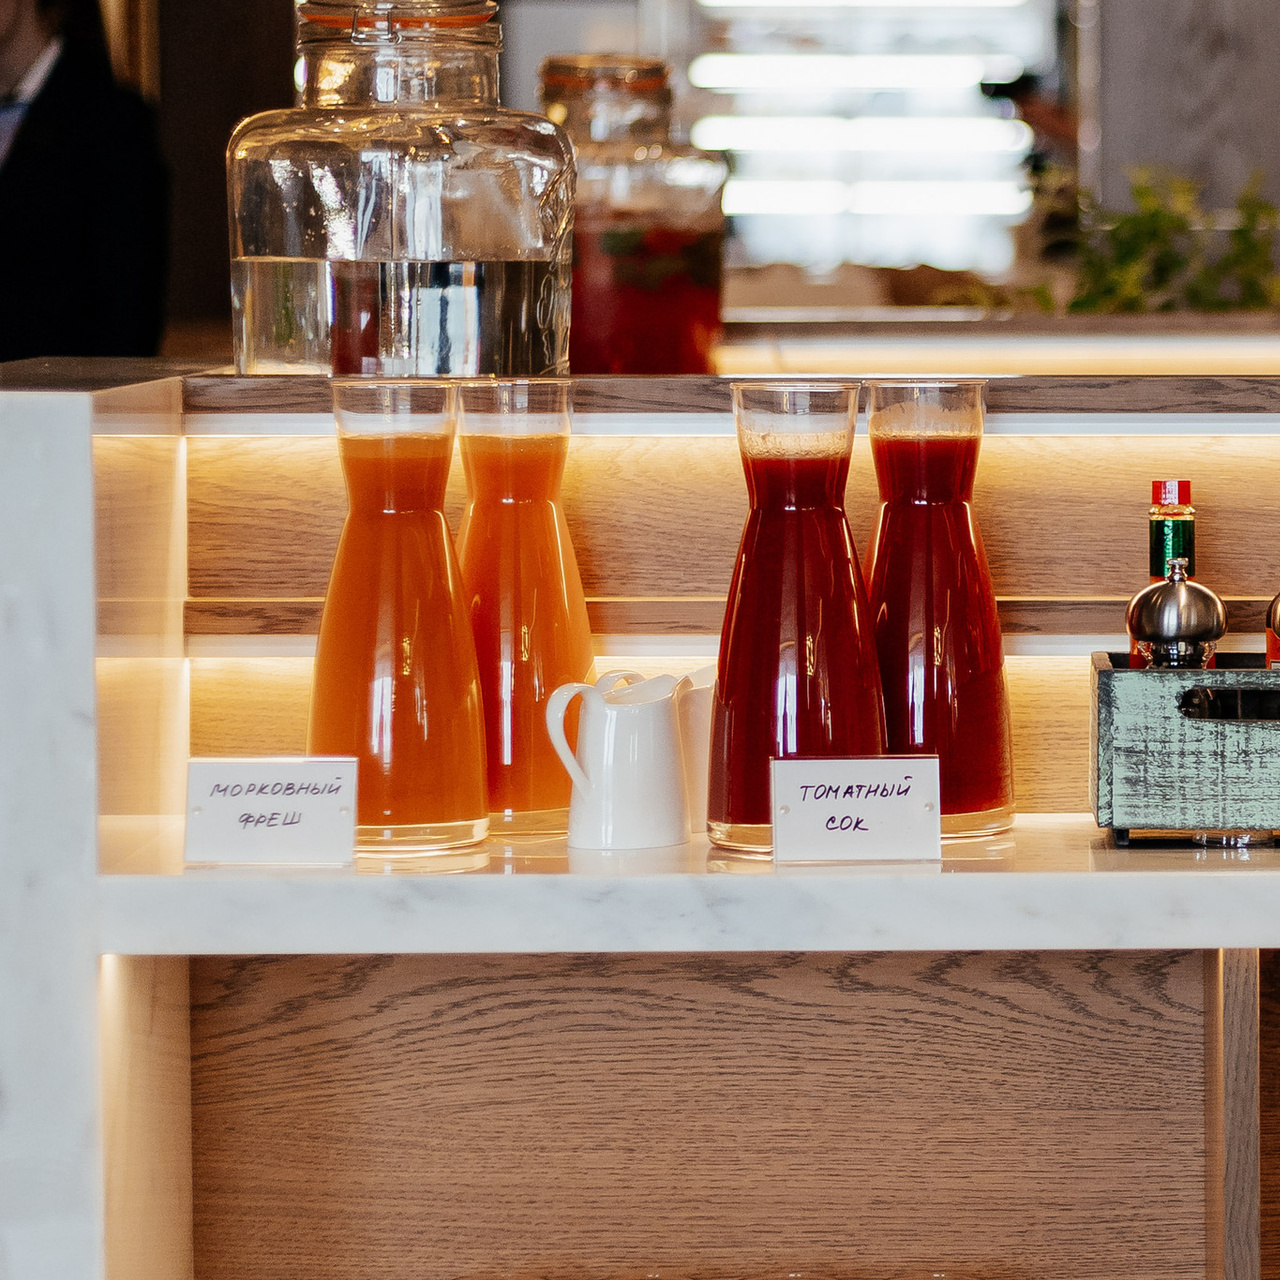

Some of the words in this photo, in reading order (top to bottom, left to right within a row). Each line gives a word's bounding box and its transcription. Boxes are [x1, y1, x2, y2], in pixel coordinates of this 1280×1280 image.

[209, 776, 342, 797] МОРКОВНЫЙ
[800, 775, 913, 801] ТОМАТНЫЙ
[238, 811, 302, 830] ФРЕШ
[825, 815, 869, 831] СОК
